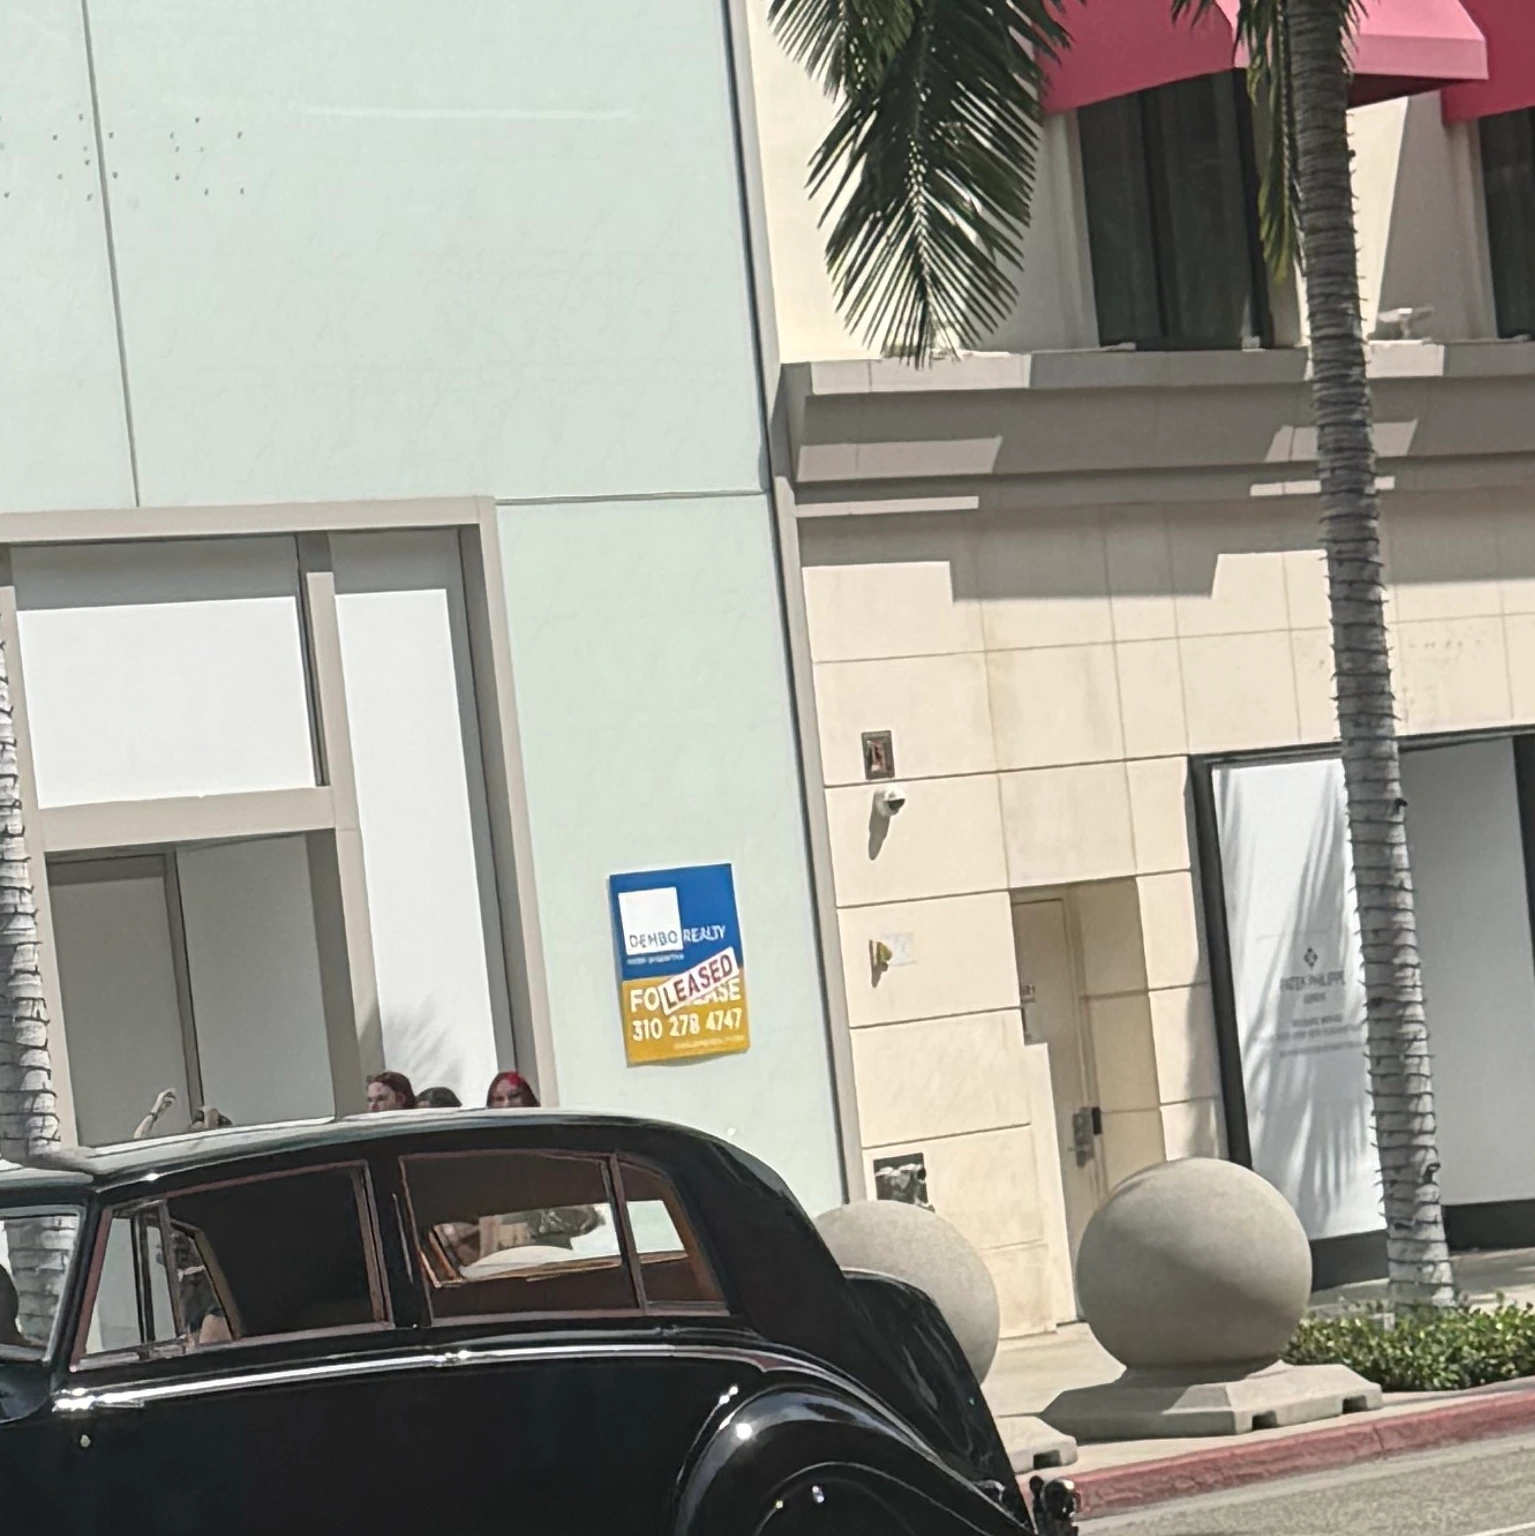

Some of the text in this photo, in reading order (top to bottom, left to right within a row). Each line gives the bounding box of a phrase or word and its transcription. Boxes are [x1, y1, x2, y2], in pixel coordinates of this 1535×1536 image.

[628, 924, 726, 949] DEMBO REALTY
[630, 977, 742, 1013] FO ASE
[663, 953, 734, 1010] LEASED
[632, 1007, 743, 1042] 310 278 4747
